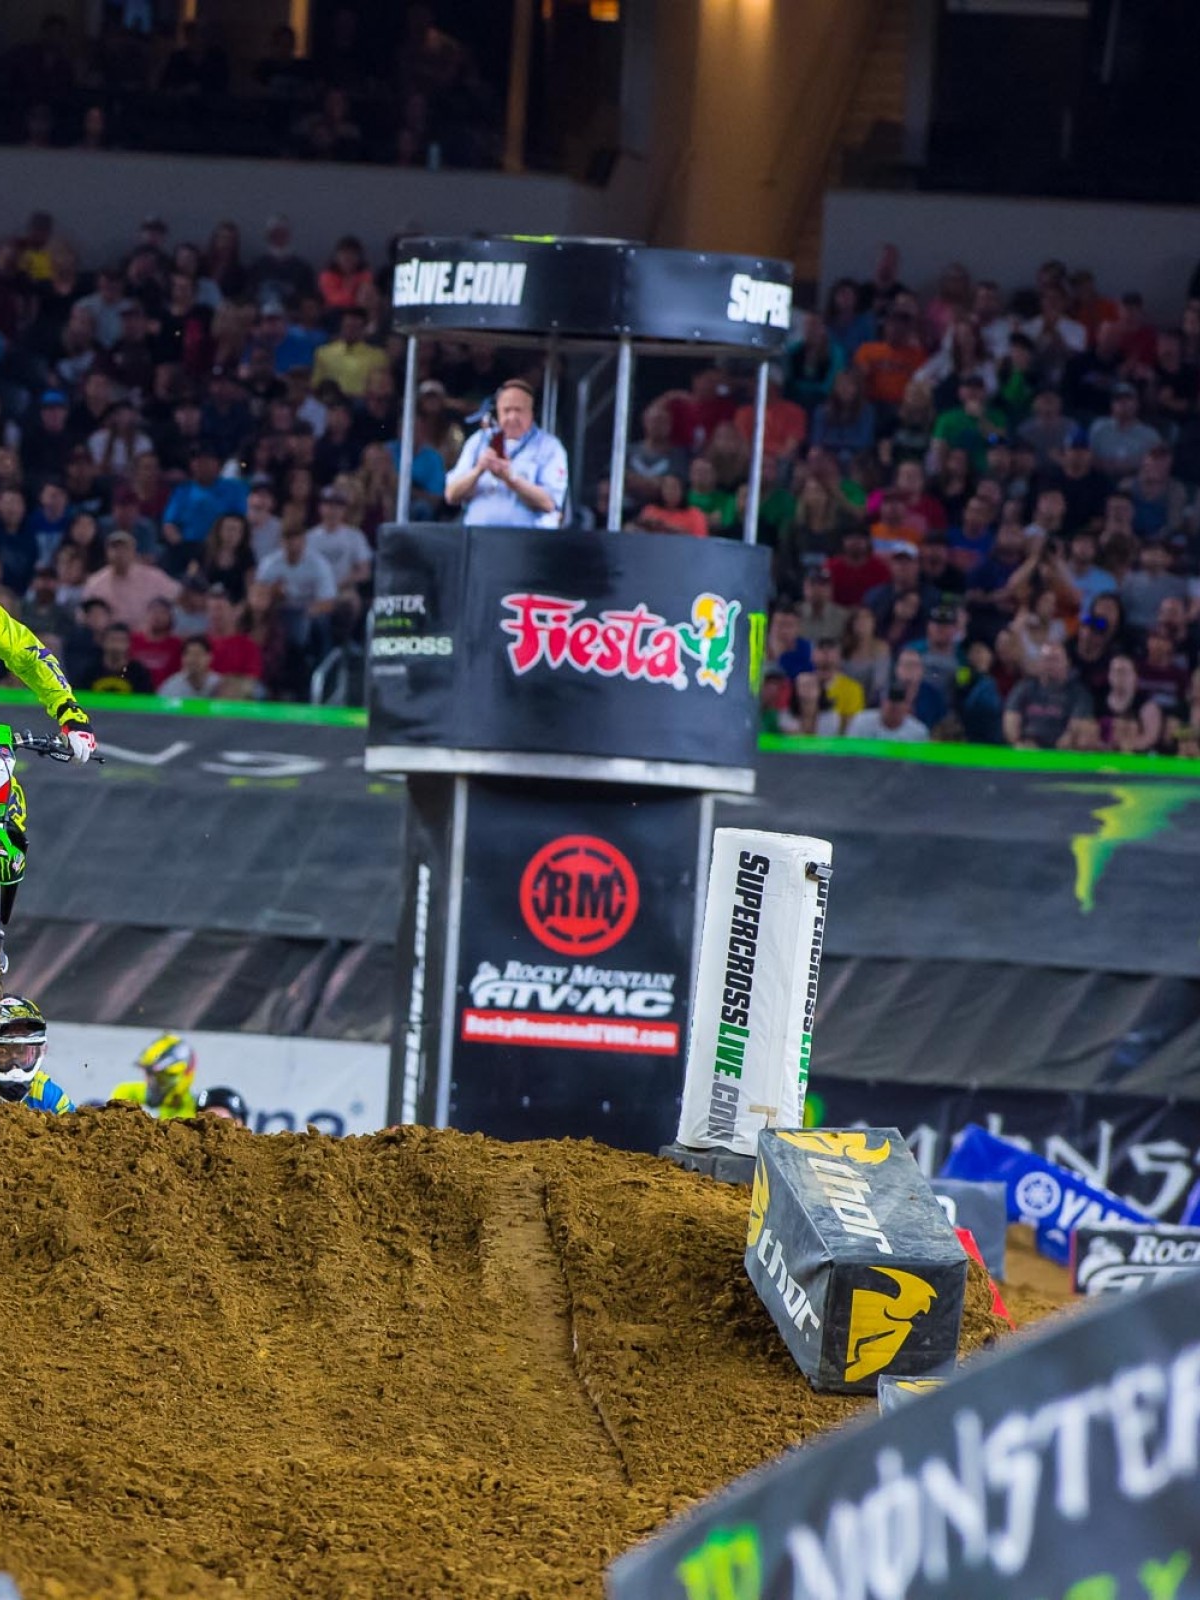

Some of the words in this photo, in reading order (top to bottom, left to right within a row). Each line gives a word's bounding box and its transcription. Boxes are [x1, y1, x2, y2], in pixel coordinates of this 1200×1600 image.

[502, 593, 688, 690] Fiesta
[545, 871, 614, 919] RM
[502, 960, 569, 984] ROCKY
[566, 964, 676, 990] MOUNTAIN
[707, 850, 771, 1143] SUPERCROSSLIVE.COM
[808, 1157, 893, 1254] thor
[757, 1228, 821, 1331] thor
